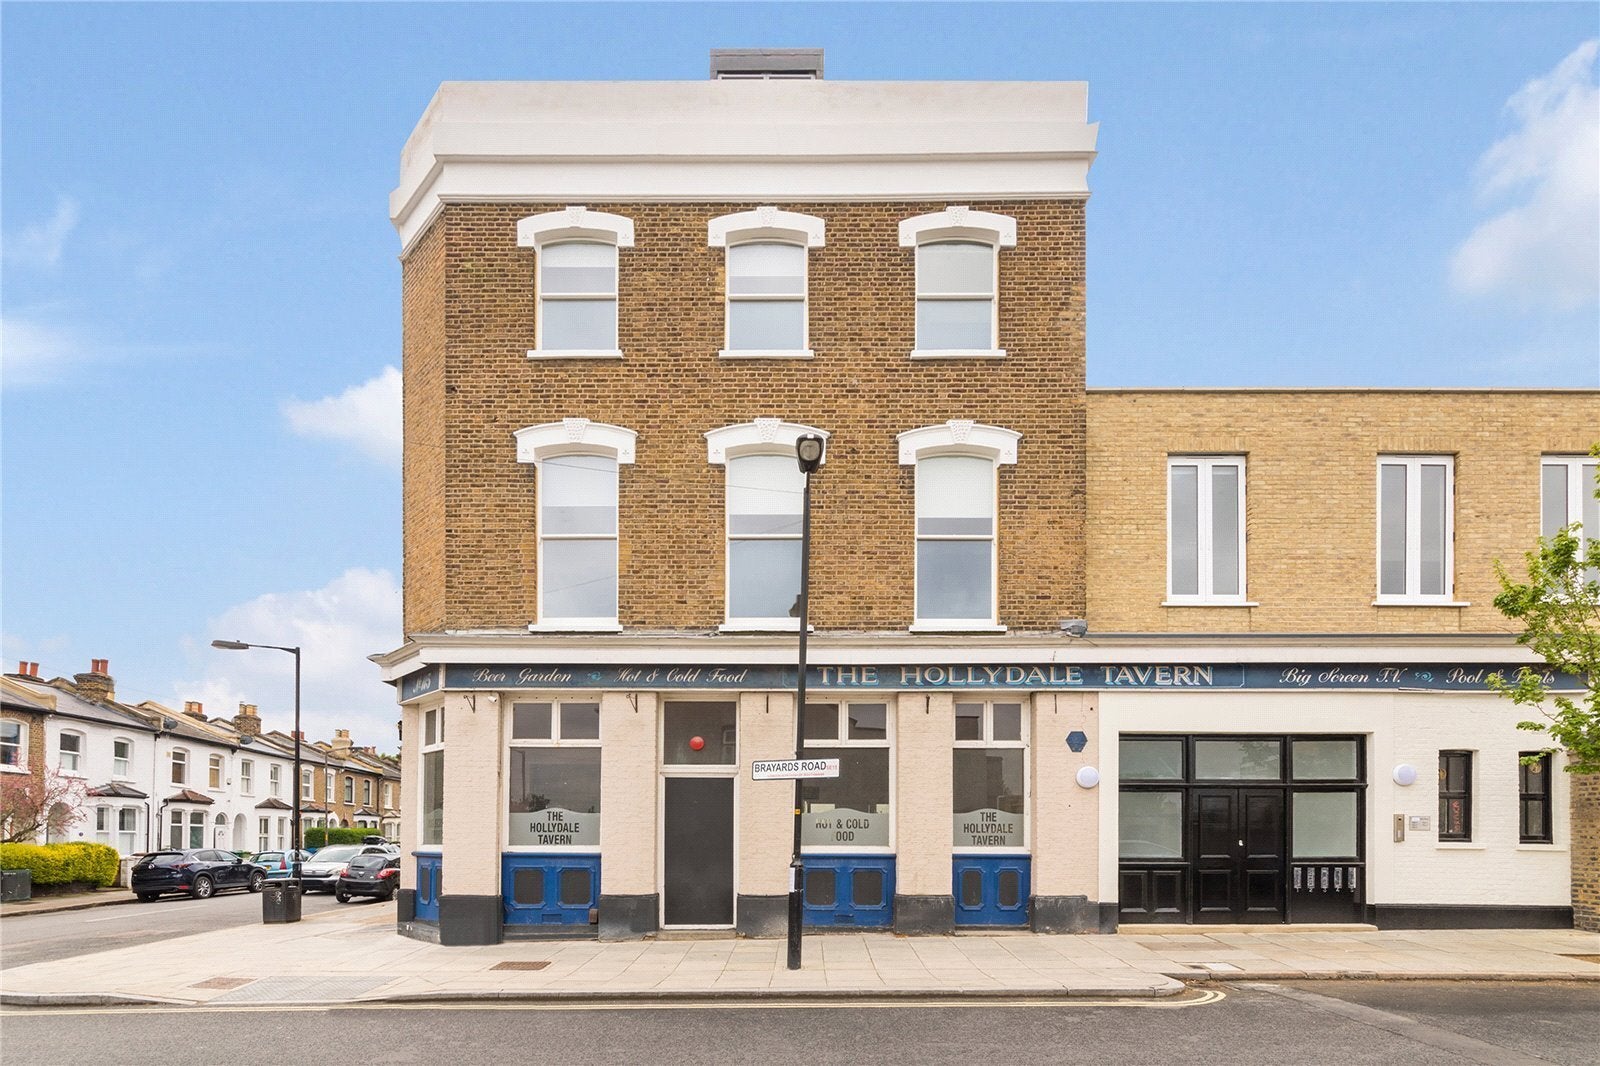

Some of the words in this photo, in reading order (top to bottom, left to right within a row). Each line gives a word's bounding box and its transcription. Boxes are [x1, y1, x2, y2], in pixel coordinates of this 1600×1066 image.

[472, 668, 506, 682] Beer
[515, 667, 572, 685] Garden
[613, 667, 642, 683] Hot
[646, 668, 660, 683] &
[666, 667, 701, 683] Cold
[706, 668, 748, 683] Food
[816, 666, 879, 686] THE
[899, 666, 1083, 686] HOLLYDALE
[1100, 665, 1214, 686] TAVERN
[1279, 667, 1312, 686] Big
[1318, 667, 1369, 683] Screen
[1445, 667, 1484, 684] Pool
[754, 762, 799, 772] BRAYARDS
[801, 761, 827, 771] ROAD
[547, 811, 563, 821] THE
[980, 812, 997, 822] THE
[530, 823, 579, 833] HOLLYDALE
[836, 819, 843, 829] &
[846, 819, 870, 829] COLD
[963, 823, 1013, 833] HOLLYDALE
[538, 834, 572, 845] TAVERN
[831, 831, 855, 842] OOD
[971, 835, 1006, 846] TAVERN
